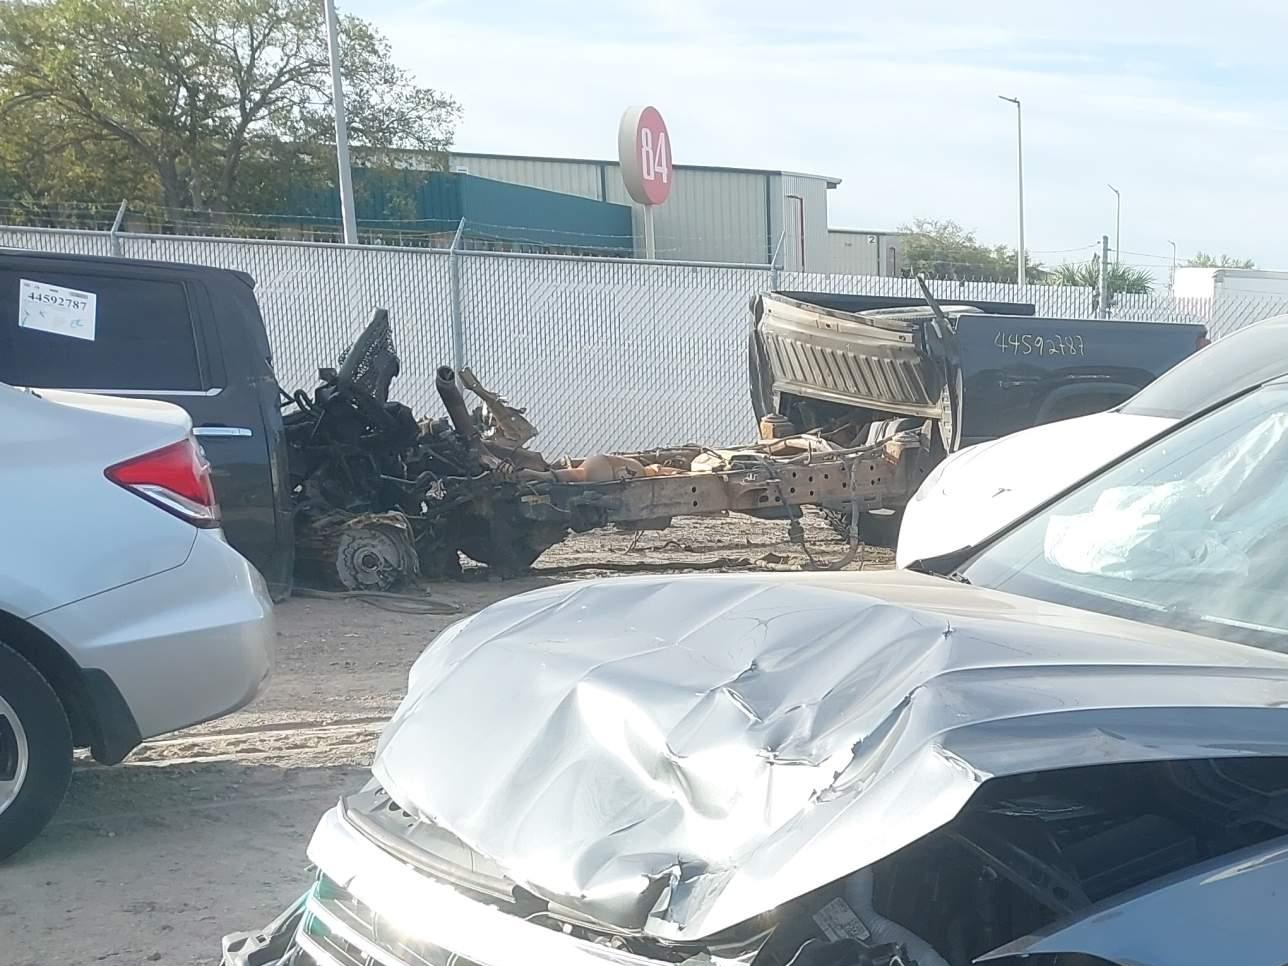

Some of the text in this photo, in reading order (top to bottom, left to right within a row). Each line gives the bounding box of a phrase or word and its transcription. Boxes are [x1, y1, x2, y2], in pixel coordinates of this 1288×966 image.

[641, 127, 668, 183] 84
[868, 235, 876, 244] 2
[27, 291, 88, 312] 44592787
[993, 331, 1085, 357] 44592787
